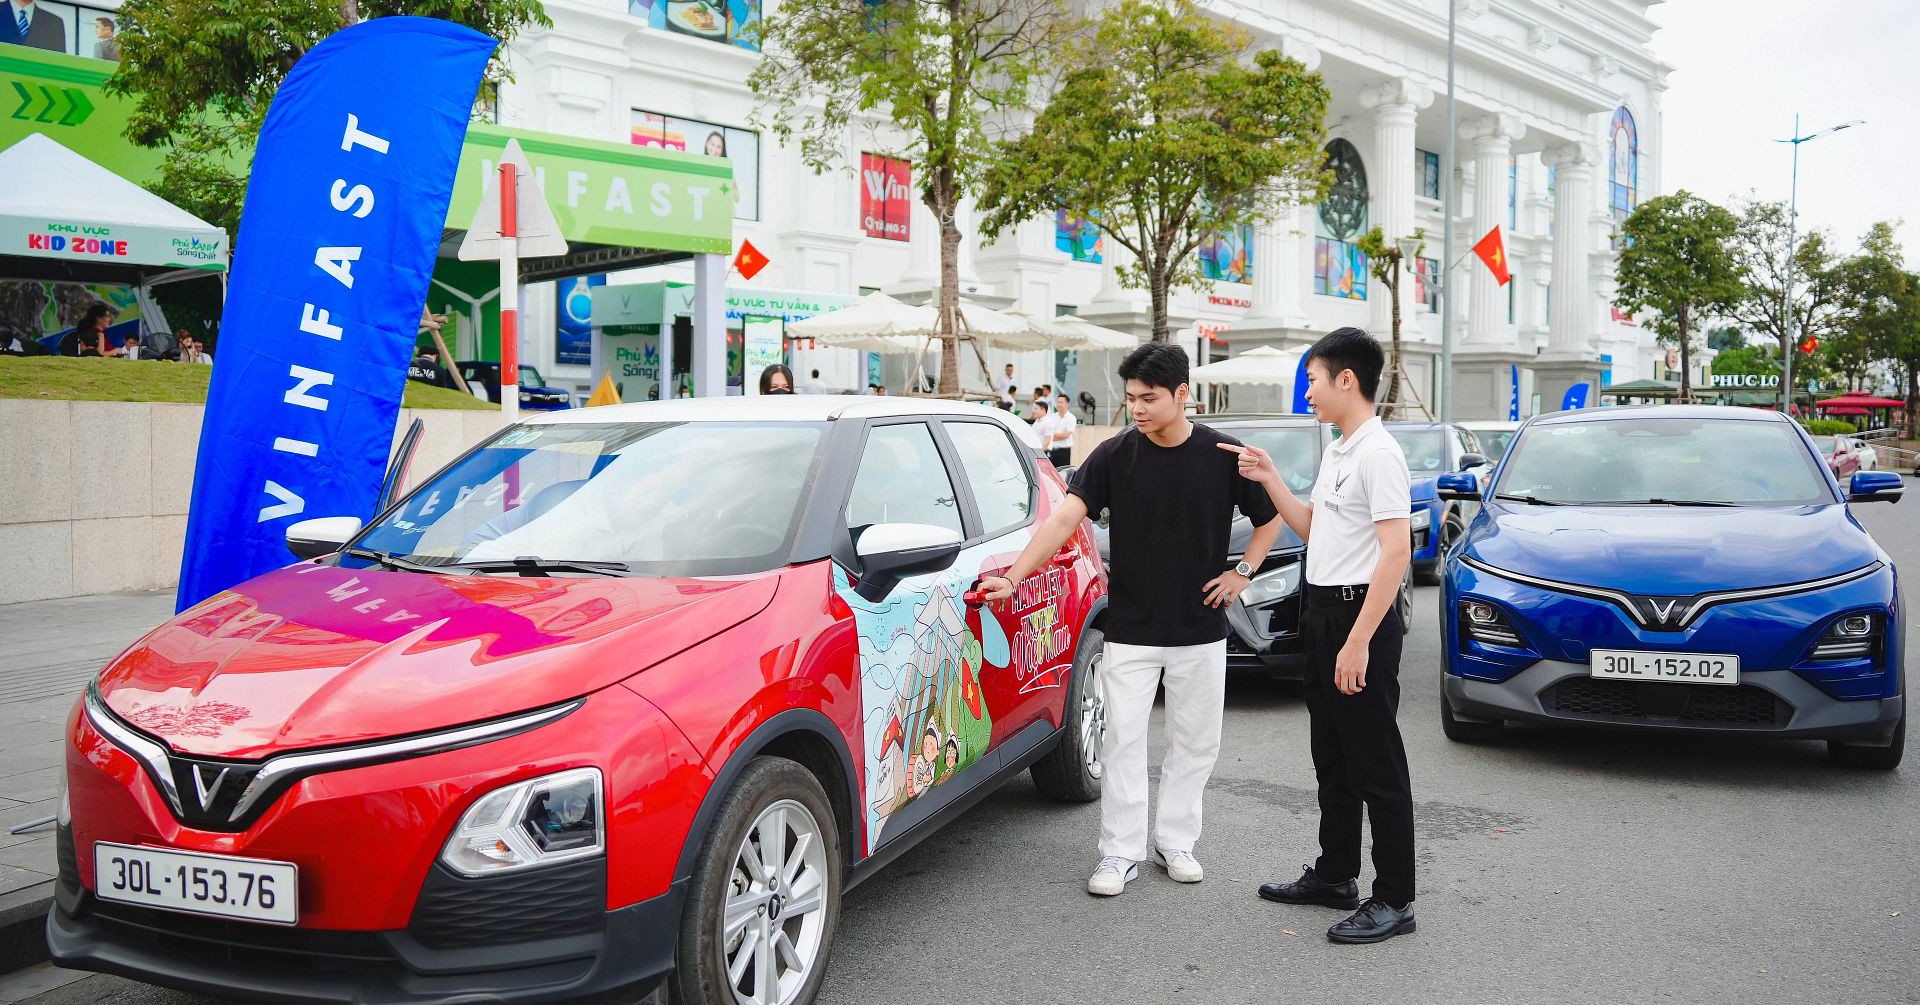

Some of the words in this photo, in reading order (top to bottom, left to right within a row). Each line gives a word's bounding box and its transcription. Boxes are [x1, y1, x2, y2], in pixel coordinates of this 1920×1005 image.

[48, 224, 78, 233] KHU
[82, 226, 110, 238] VỰC
[28, 233, 66, 251] KID
[72, 237, 128, 256] ZONE
[257, 112, 391, 524] VINFAST
[1604, 655, 1725, 679] 30L-152.02
[111, 856, 276, 909] 30L-153.76
